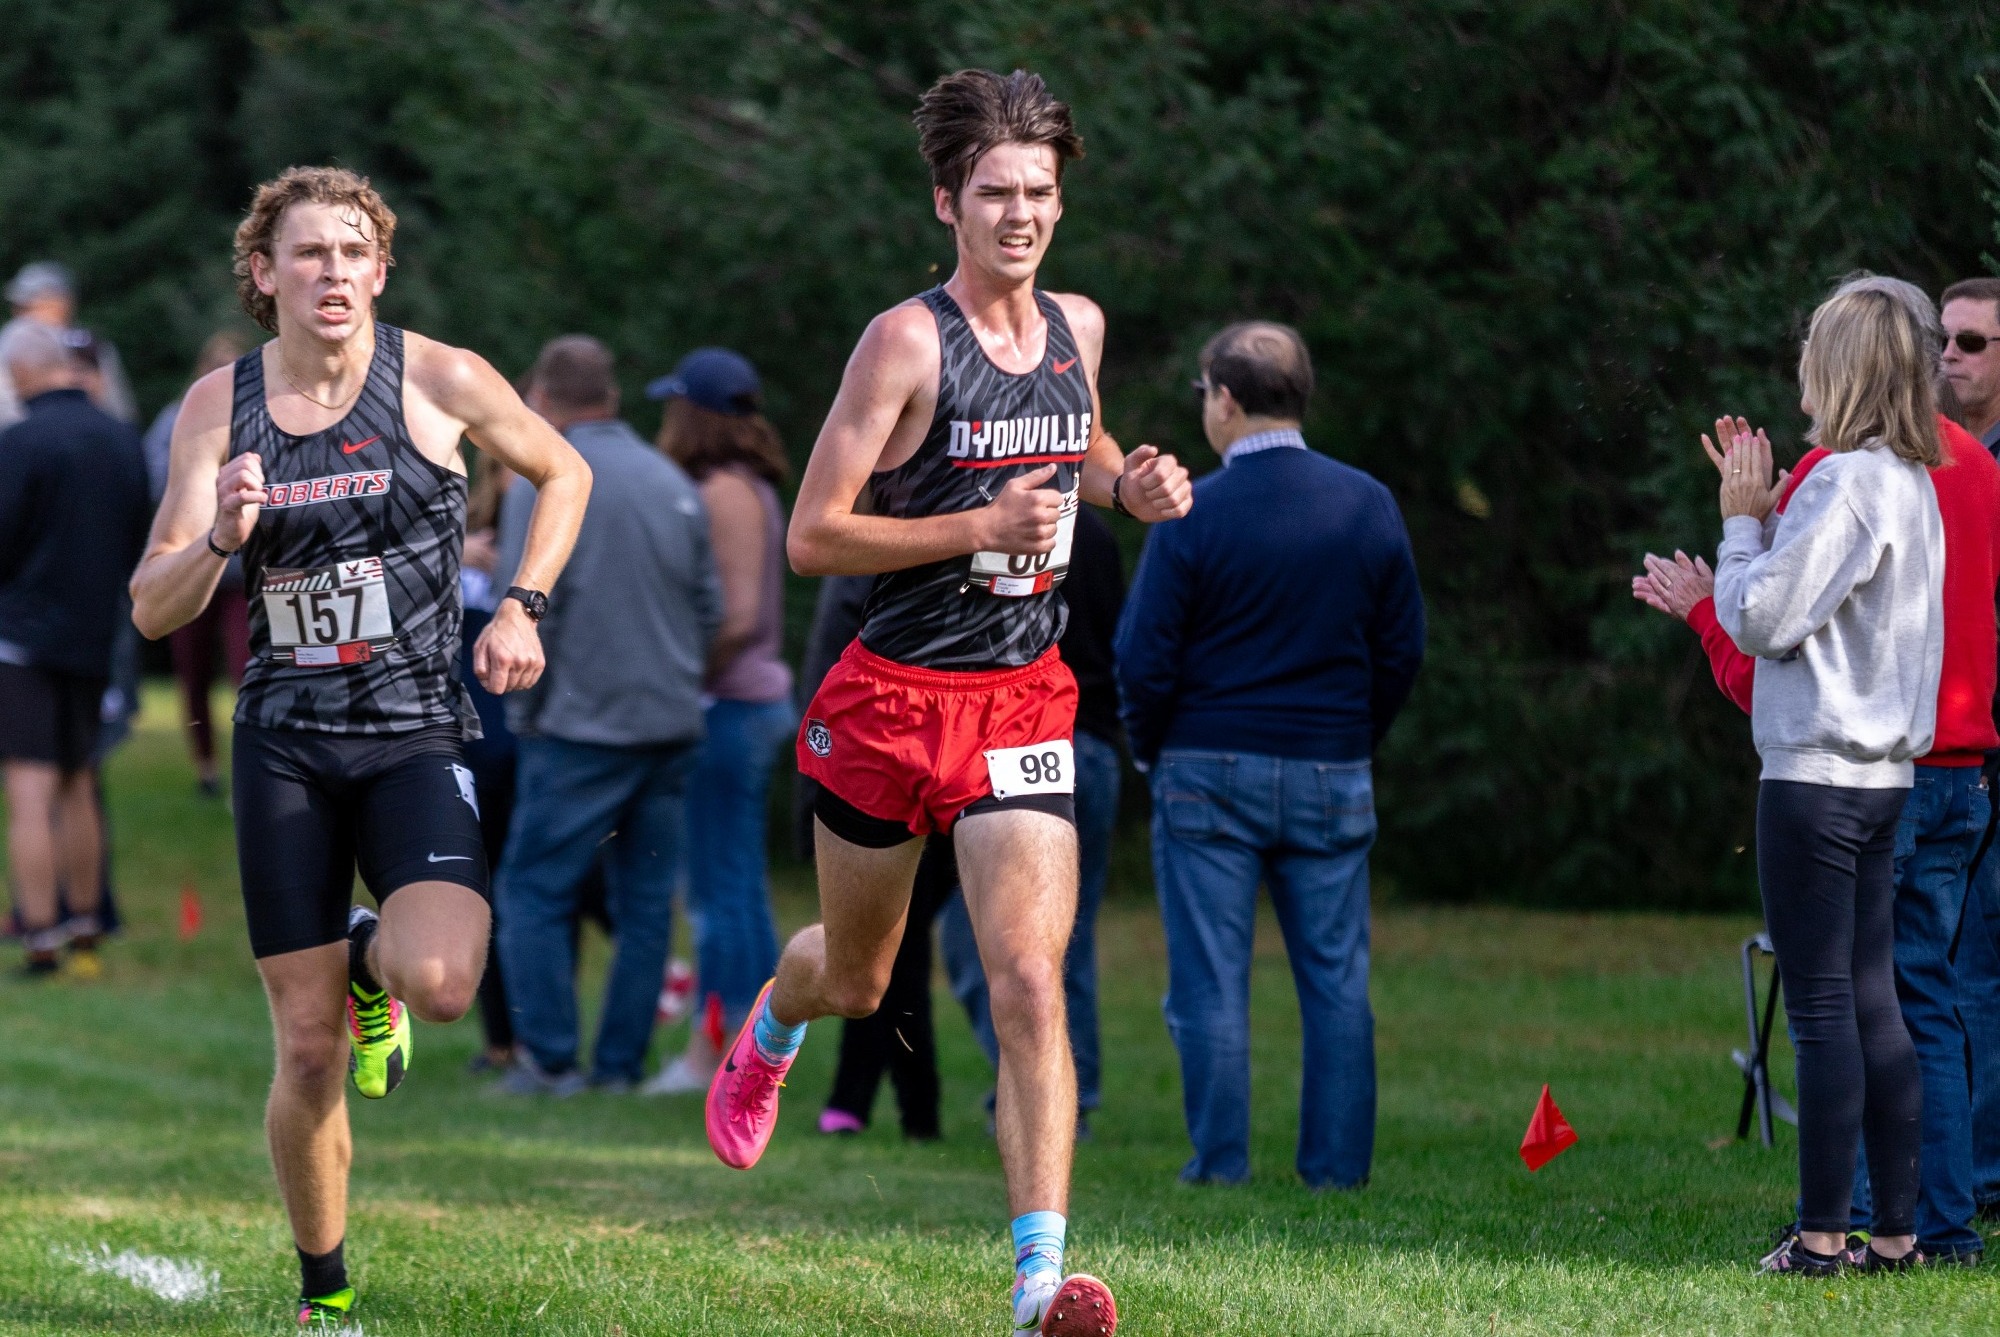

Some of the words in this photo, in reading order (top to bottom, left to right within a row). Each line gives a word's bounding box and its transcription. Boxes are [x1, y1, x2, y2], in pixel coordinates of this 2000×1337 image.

[948, 413, 1091, 458] D'YOUVILLE
[286, 586, 363, 644] 157
[1020, 751, 1061, 785] 98
